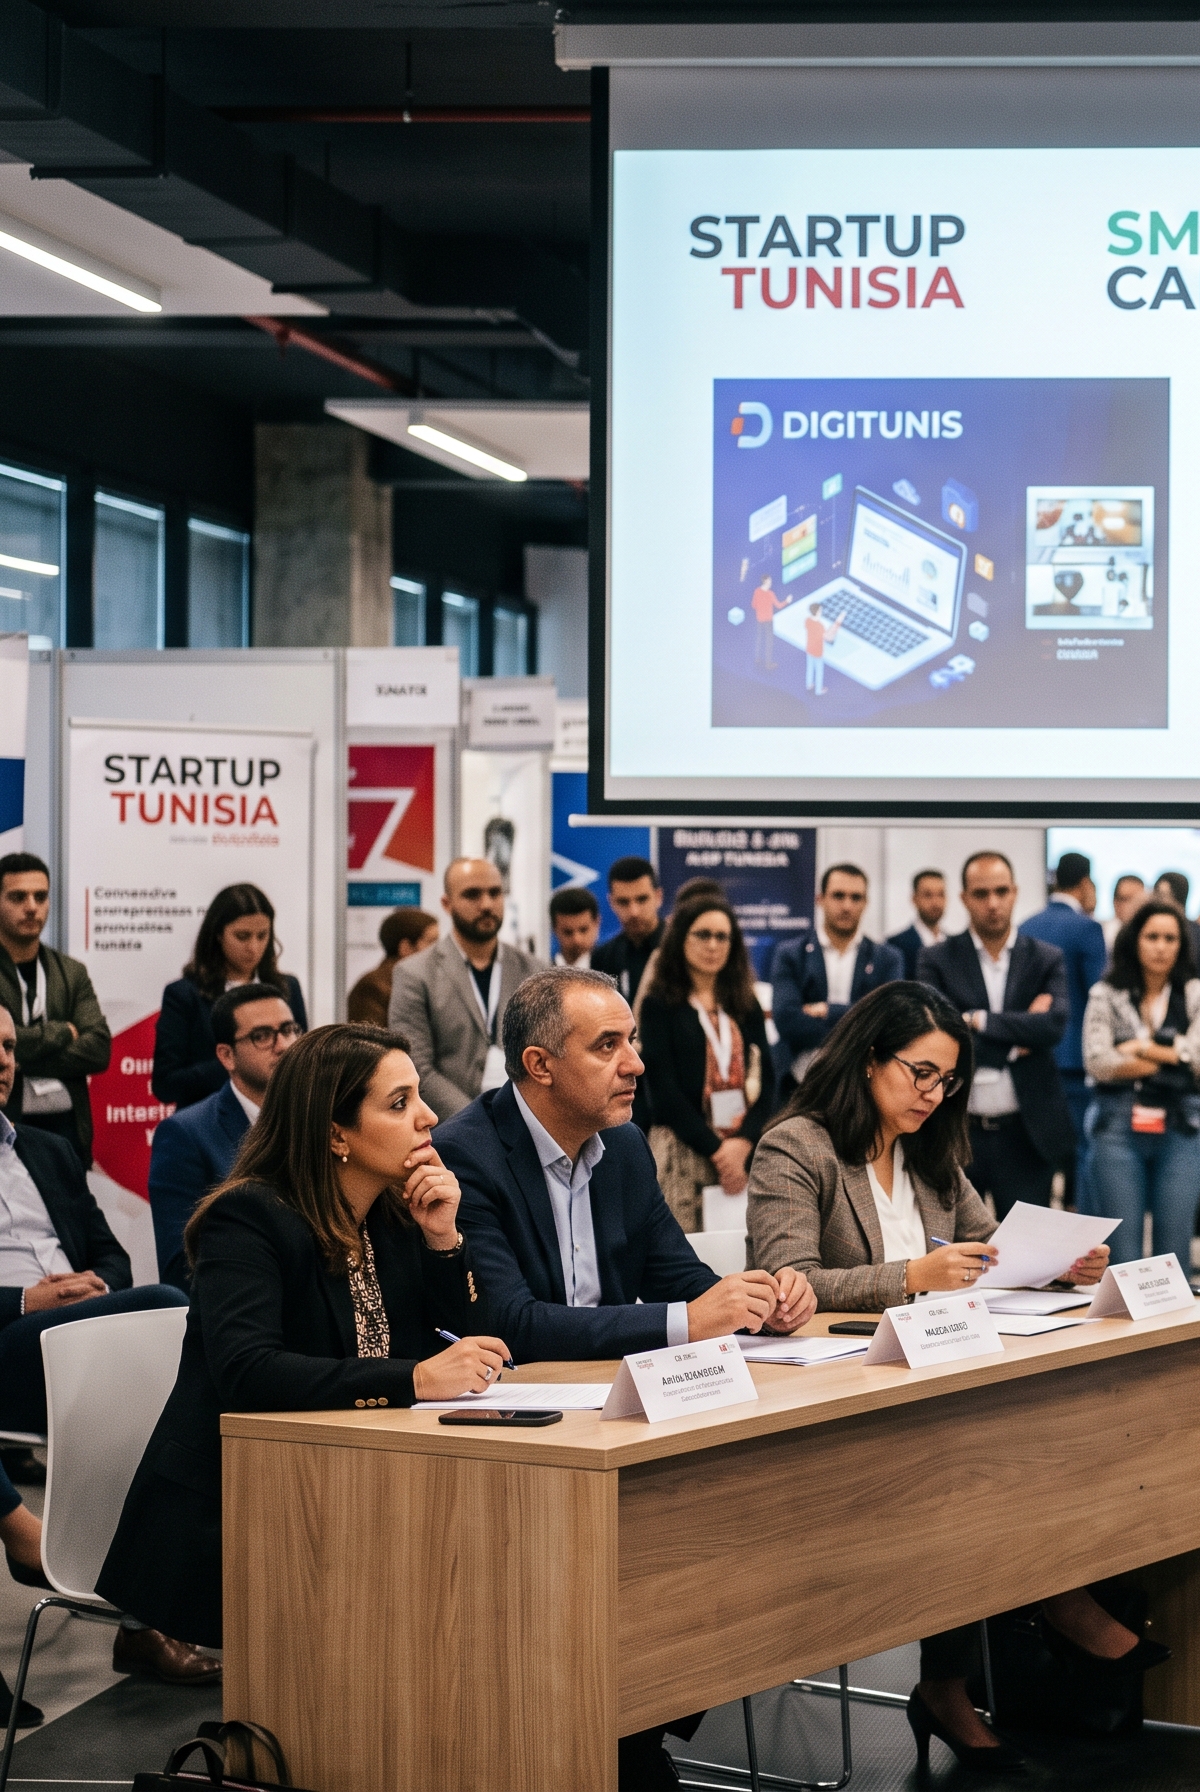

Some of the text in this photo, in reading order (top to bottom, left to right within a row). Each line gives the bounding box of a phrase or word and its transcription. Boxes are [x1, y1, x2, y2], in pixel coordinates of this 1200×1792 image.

[689, 214, 966, 259] STARTUP
[721, 266, 965, 309] TUNISIA
[783, 410, 964, 439] DIGITUNIS
[104, 754, 281, 788] STARTUP
[110, 791, 279, 828] TUNISIA
